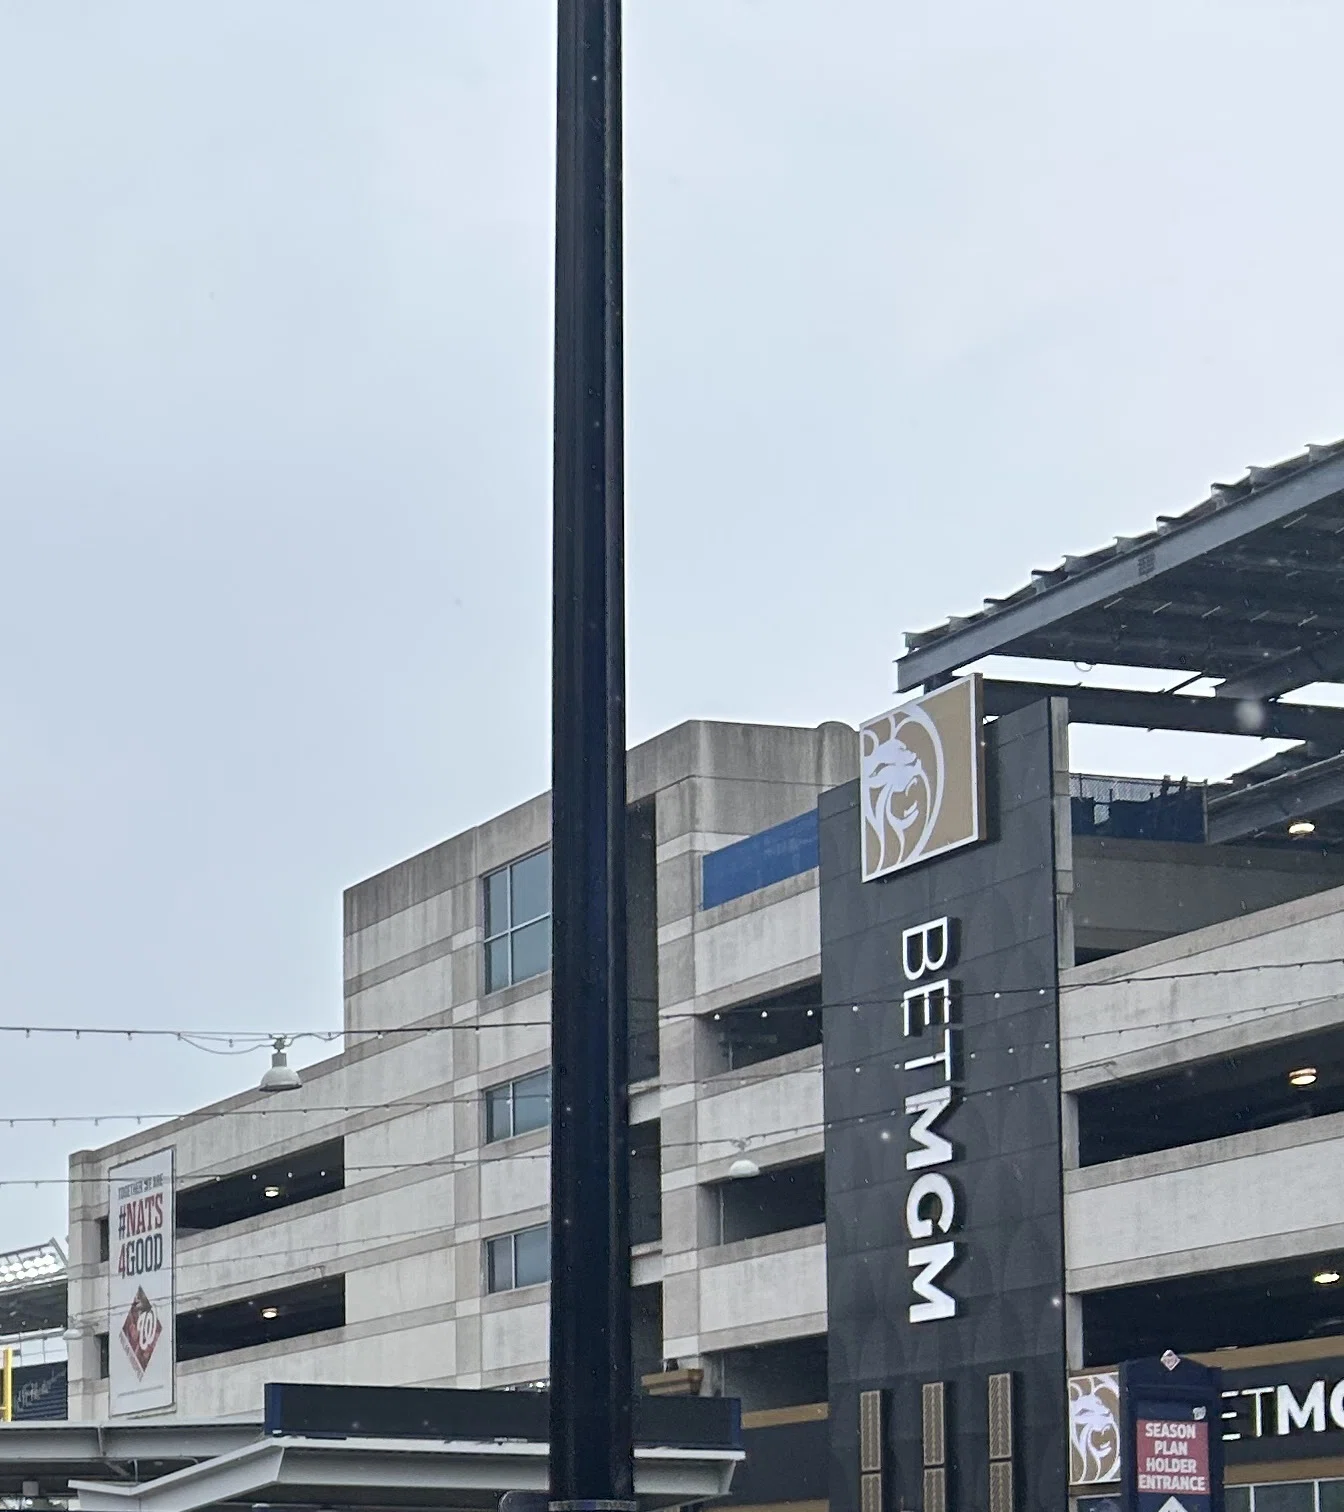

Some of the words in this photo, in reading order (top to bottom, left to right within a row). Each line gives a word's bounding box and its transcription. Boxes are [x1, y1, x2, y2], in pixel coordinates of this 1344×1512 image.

[901, 916, 957, 1324] BETMGM
[118, 1192, 164, 1240] #NATS
[117, 1233, 163, 1279] 4GOOD
[1221, 1378, 1344, 1440] ETM
[1145, 1422, 1196, 1439] SEASON
[1154, 1441, 1188, 1457] PLAN
[1146, 1458, 1197, 1473] HOLDER
[1138, 1475, 1206, 1491] ENTRANCE
